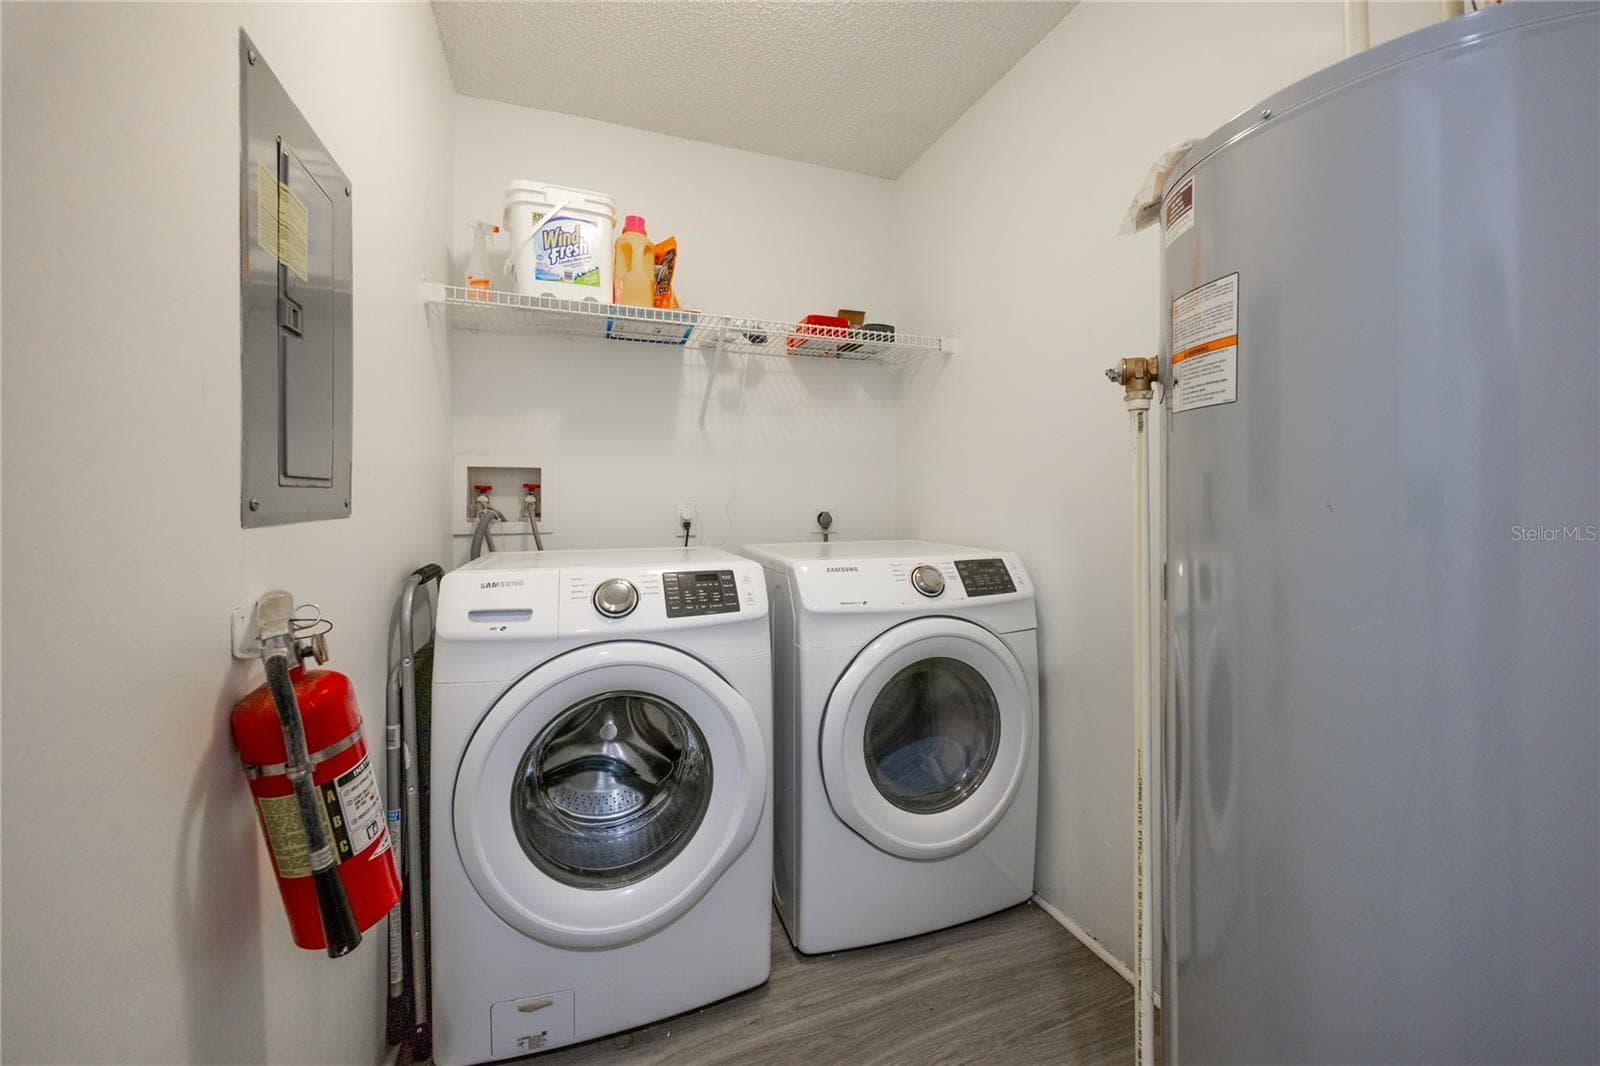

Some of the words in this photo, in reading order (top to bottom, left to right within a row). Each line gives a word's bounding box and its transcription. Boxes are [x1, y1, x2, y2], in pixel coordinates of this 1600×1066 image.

[542, 224, 581, 251] Wind
[547, 236, 591, 266] Fresh
[480, 579, 525, 590] SAMSUNG
[327, 790, 337, 804] A
[332, 815, 343, 829] B
[339, 838, 350, 853] C
